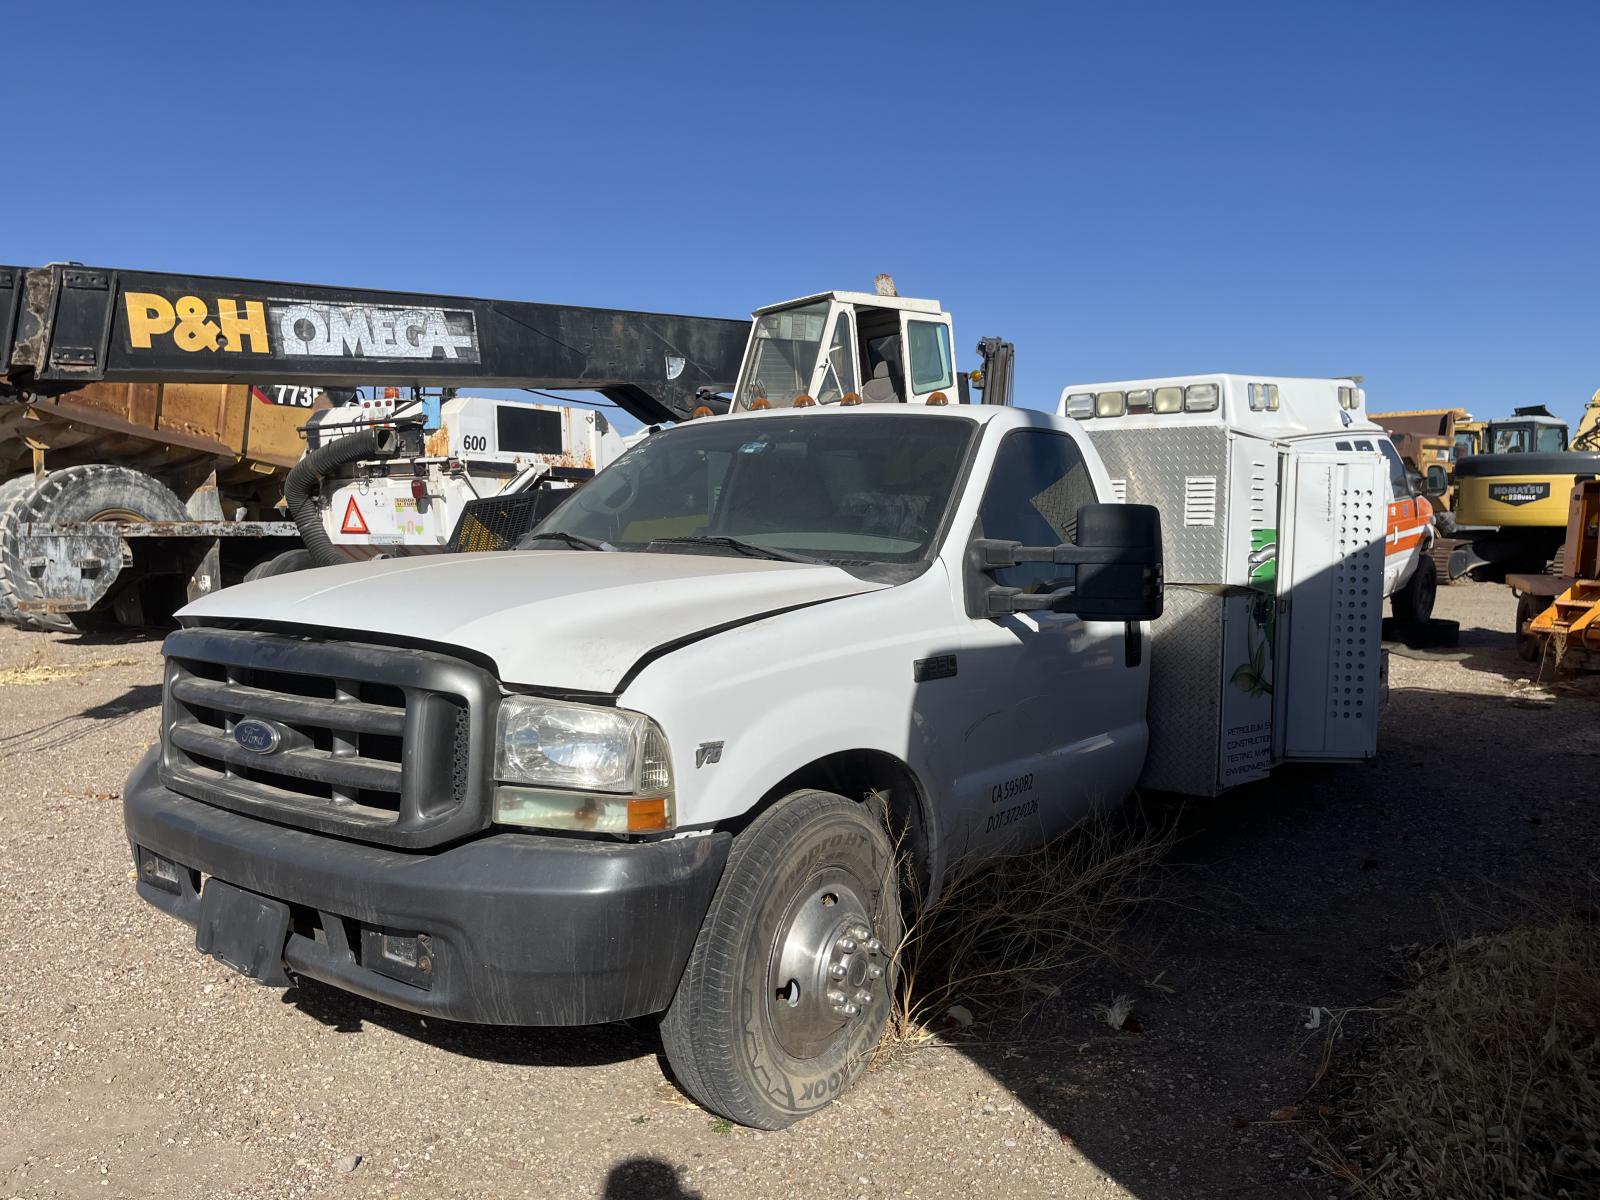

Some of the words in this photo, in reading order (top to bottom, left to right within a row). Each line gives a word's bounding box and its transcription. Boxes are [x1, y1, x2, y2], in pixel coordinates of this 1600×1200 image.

[124, 291, 270, 354] P&H
[463, 434, 487, 451] 600
[1493, 484, 1544, 495] KOMATSU
[241, 726, 267, 746] Ford
[1226, 734, 1271, 750] CONSTRUCTIO
[992, 783, 1003, 804] CA
[1003, 773, 1034, 800] 595082
[986, 810, 1005, 834] DOT
